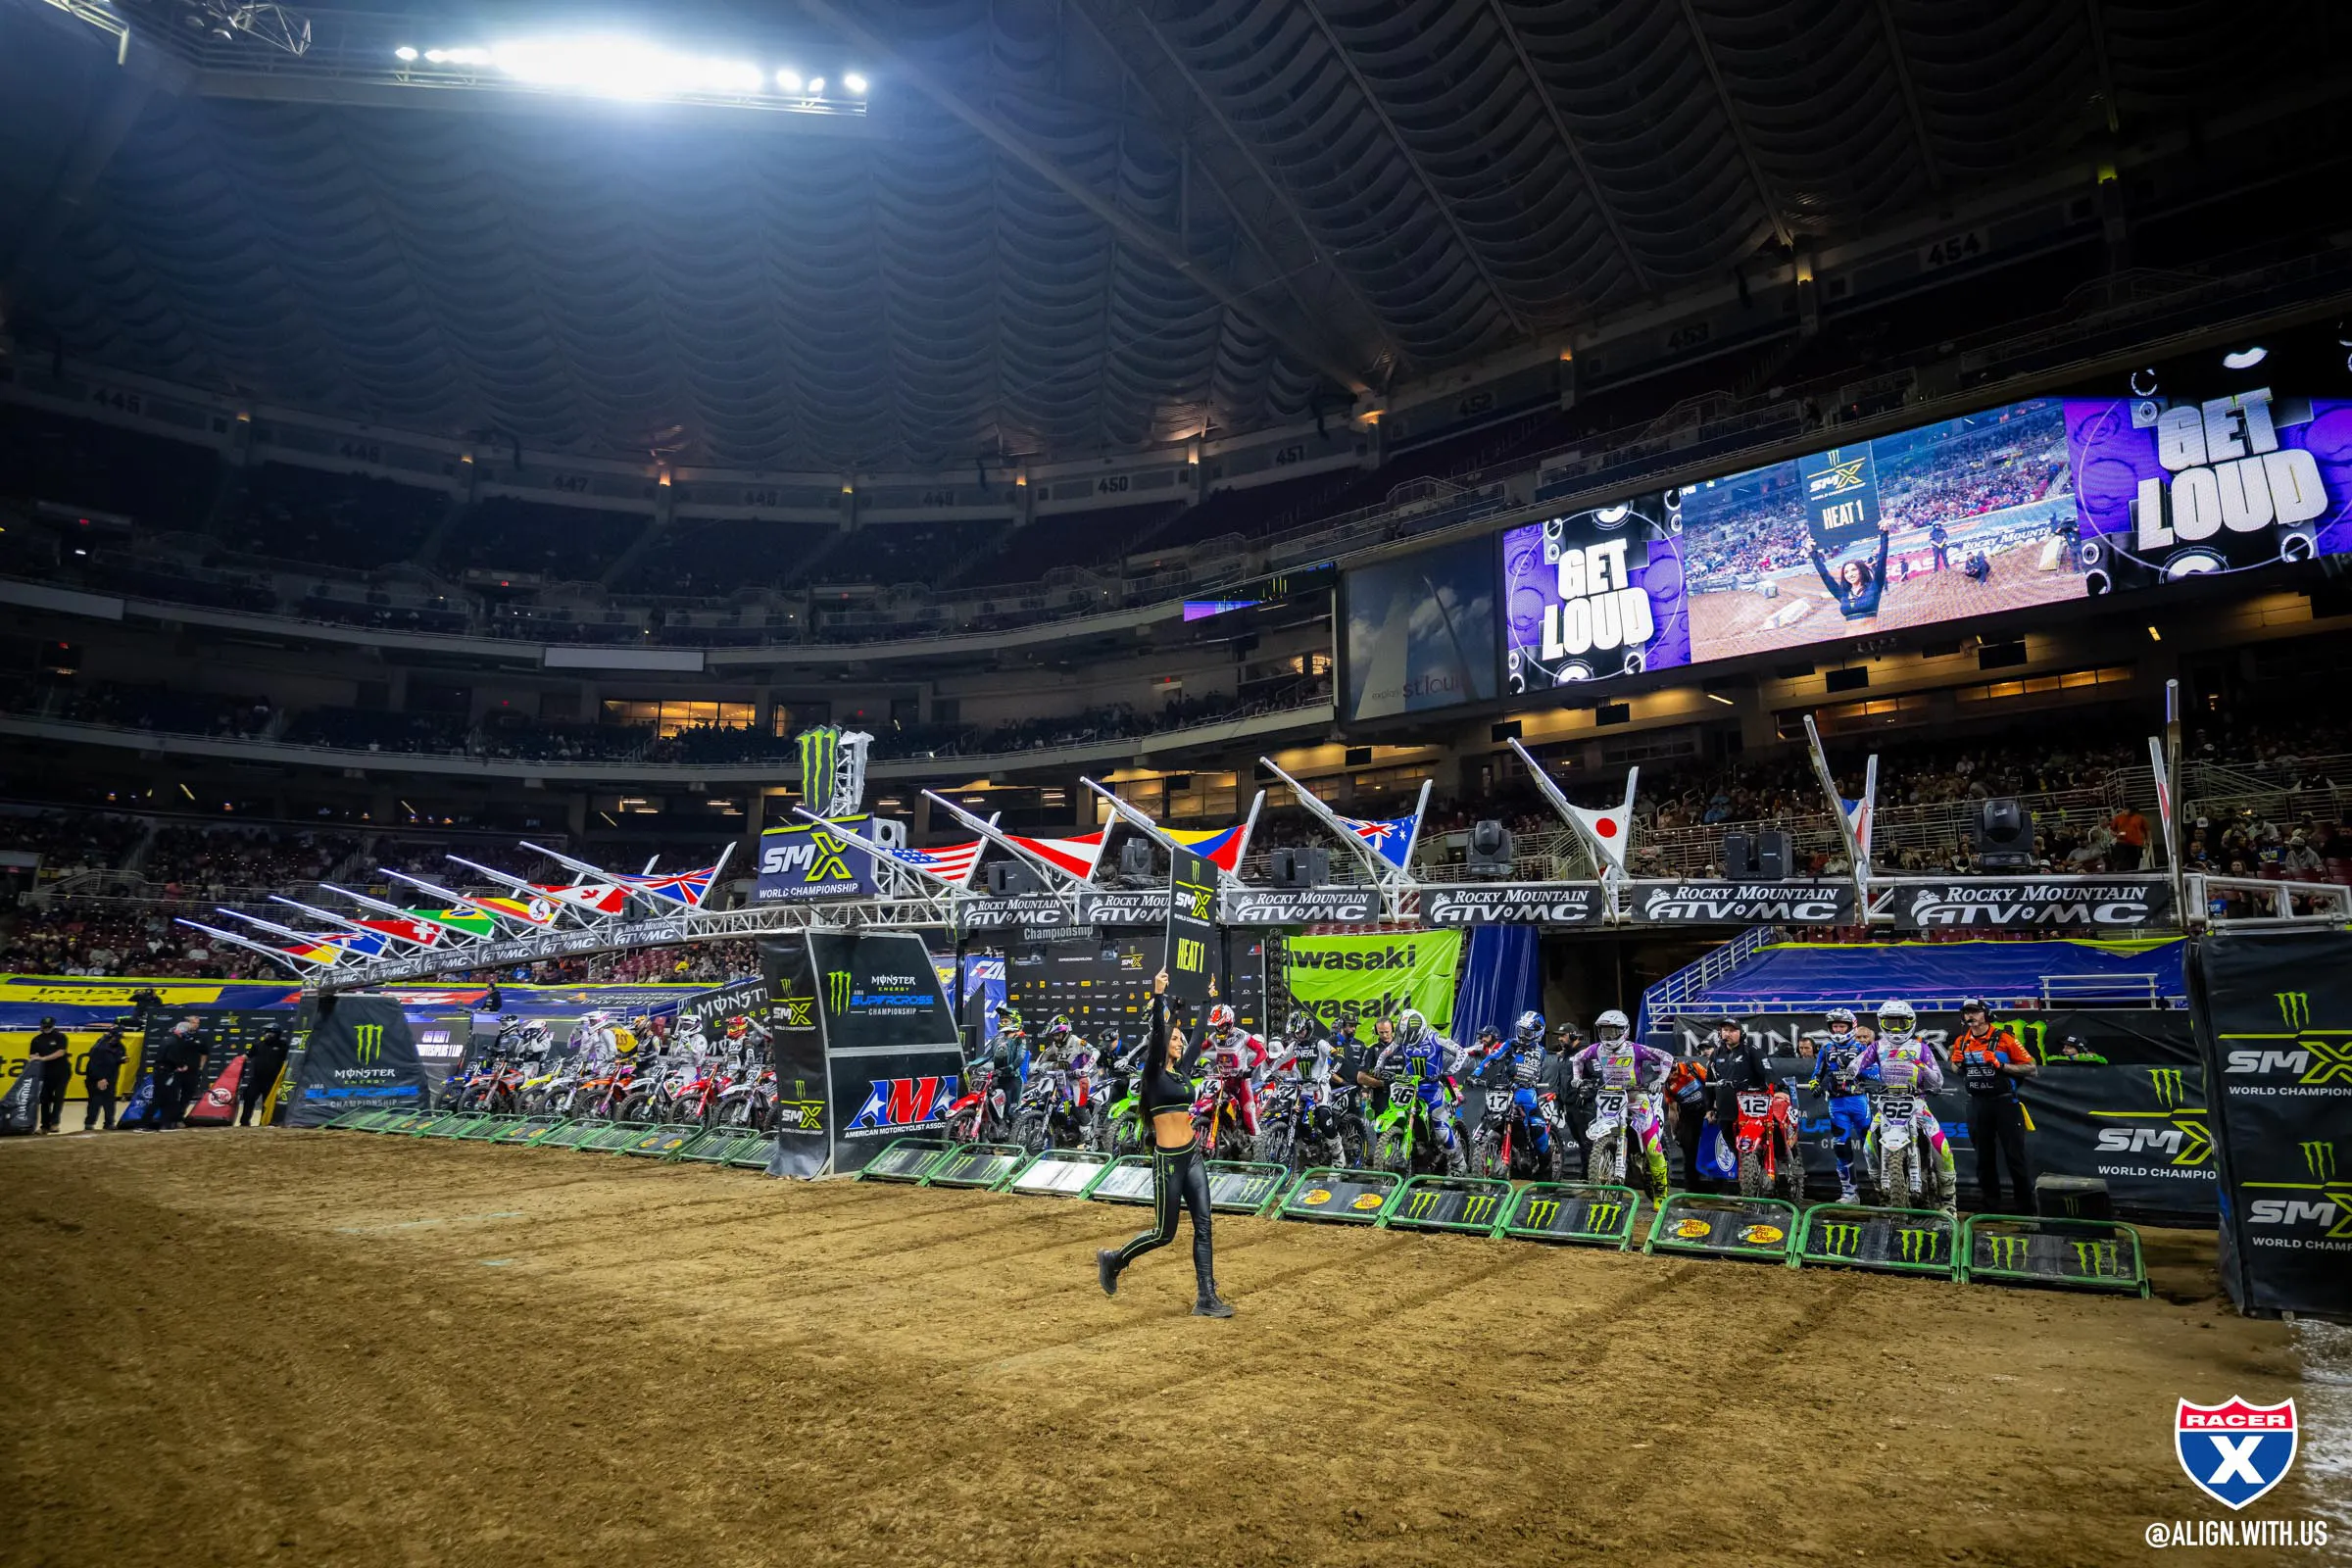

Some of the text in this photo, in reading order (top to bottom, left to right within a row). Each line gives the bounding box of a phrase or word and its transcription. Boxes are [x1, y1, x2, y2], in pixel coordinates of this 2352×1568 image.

[1927, 232, 1980, 266] 454
[2158, 386, 2278, 470] GET
[1275, 445, 1303, 466] 451
[1098, 476, 1128, 494] 450
[2138, 449, 2328, 551] LOUD
[1823, 500, 1864, 530] HEAT 1
[1558, 538, 1628, 600] GET
[1542, 587, 1654, 661] LOUD
[761, 828, 858, 881] SMX
[760, 883, 858, 899] WORLD CHAMPIONSHIP
[1256, 892, 1369, 905] ROCKY MOUNTAIN
[1453, 889, 1590, 904] ROCKY MOUNTAIN
[1674, 886, 1838, 901] ROCKY MOUNTAIN
[1945, 886, 2148, 903] ROCKY MOUNTAIN
[978, 899, 1060, 910] ROCKY MOUNTAIN
[1104, 896, 1139, 906] ROCKY
[1175, 891, 1211, 919] SMX
[1177, 938, 1205, 973] HEAT 1
[851, 995, 934, 1005] SUPERCROSS
[773, 1003, 811, 1025] SMX
[2225, 1042, 2352, 1084] SMX
[1392, 1088, 1414, 1103] 36
[2229, 1087, 2352, 1097] WORLD CHAMPION
[844, 1075, 958, 1130] AMA
[1490, 1096, 1506, 1108] 17
[1599, 1097, 1623, 1110] 78
[1743, 1099, 1767, 1113] 12
[1883, 1102, 1913, 1118] 62
[781, 1106, 823, 1129] SMX
[845, 1129, 878, 1139] AMERICAN
[879, 1124, 925, 1135] MOTORCYCLIST
[2098, 1165, 2217, 1179] WORLD CHAMPIO
[2253, 1238, 2301, 1249] WORLD
